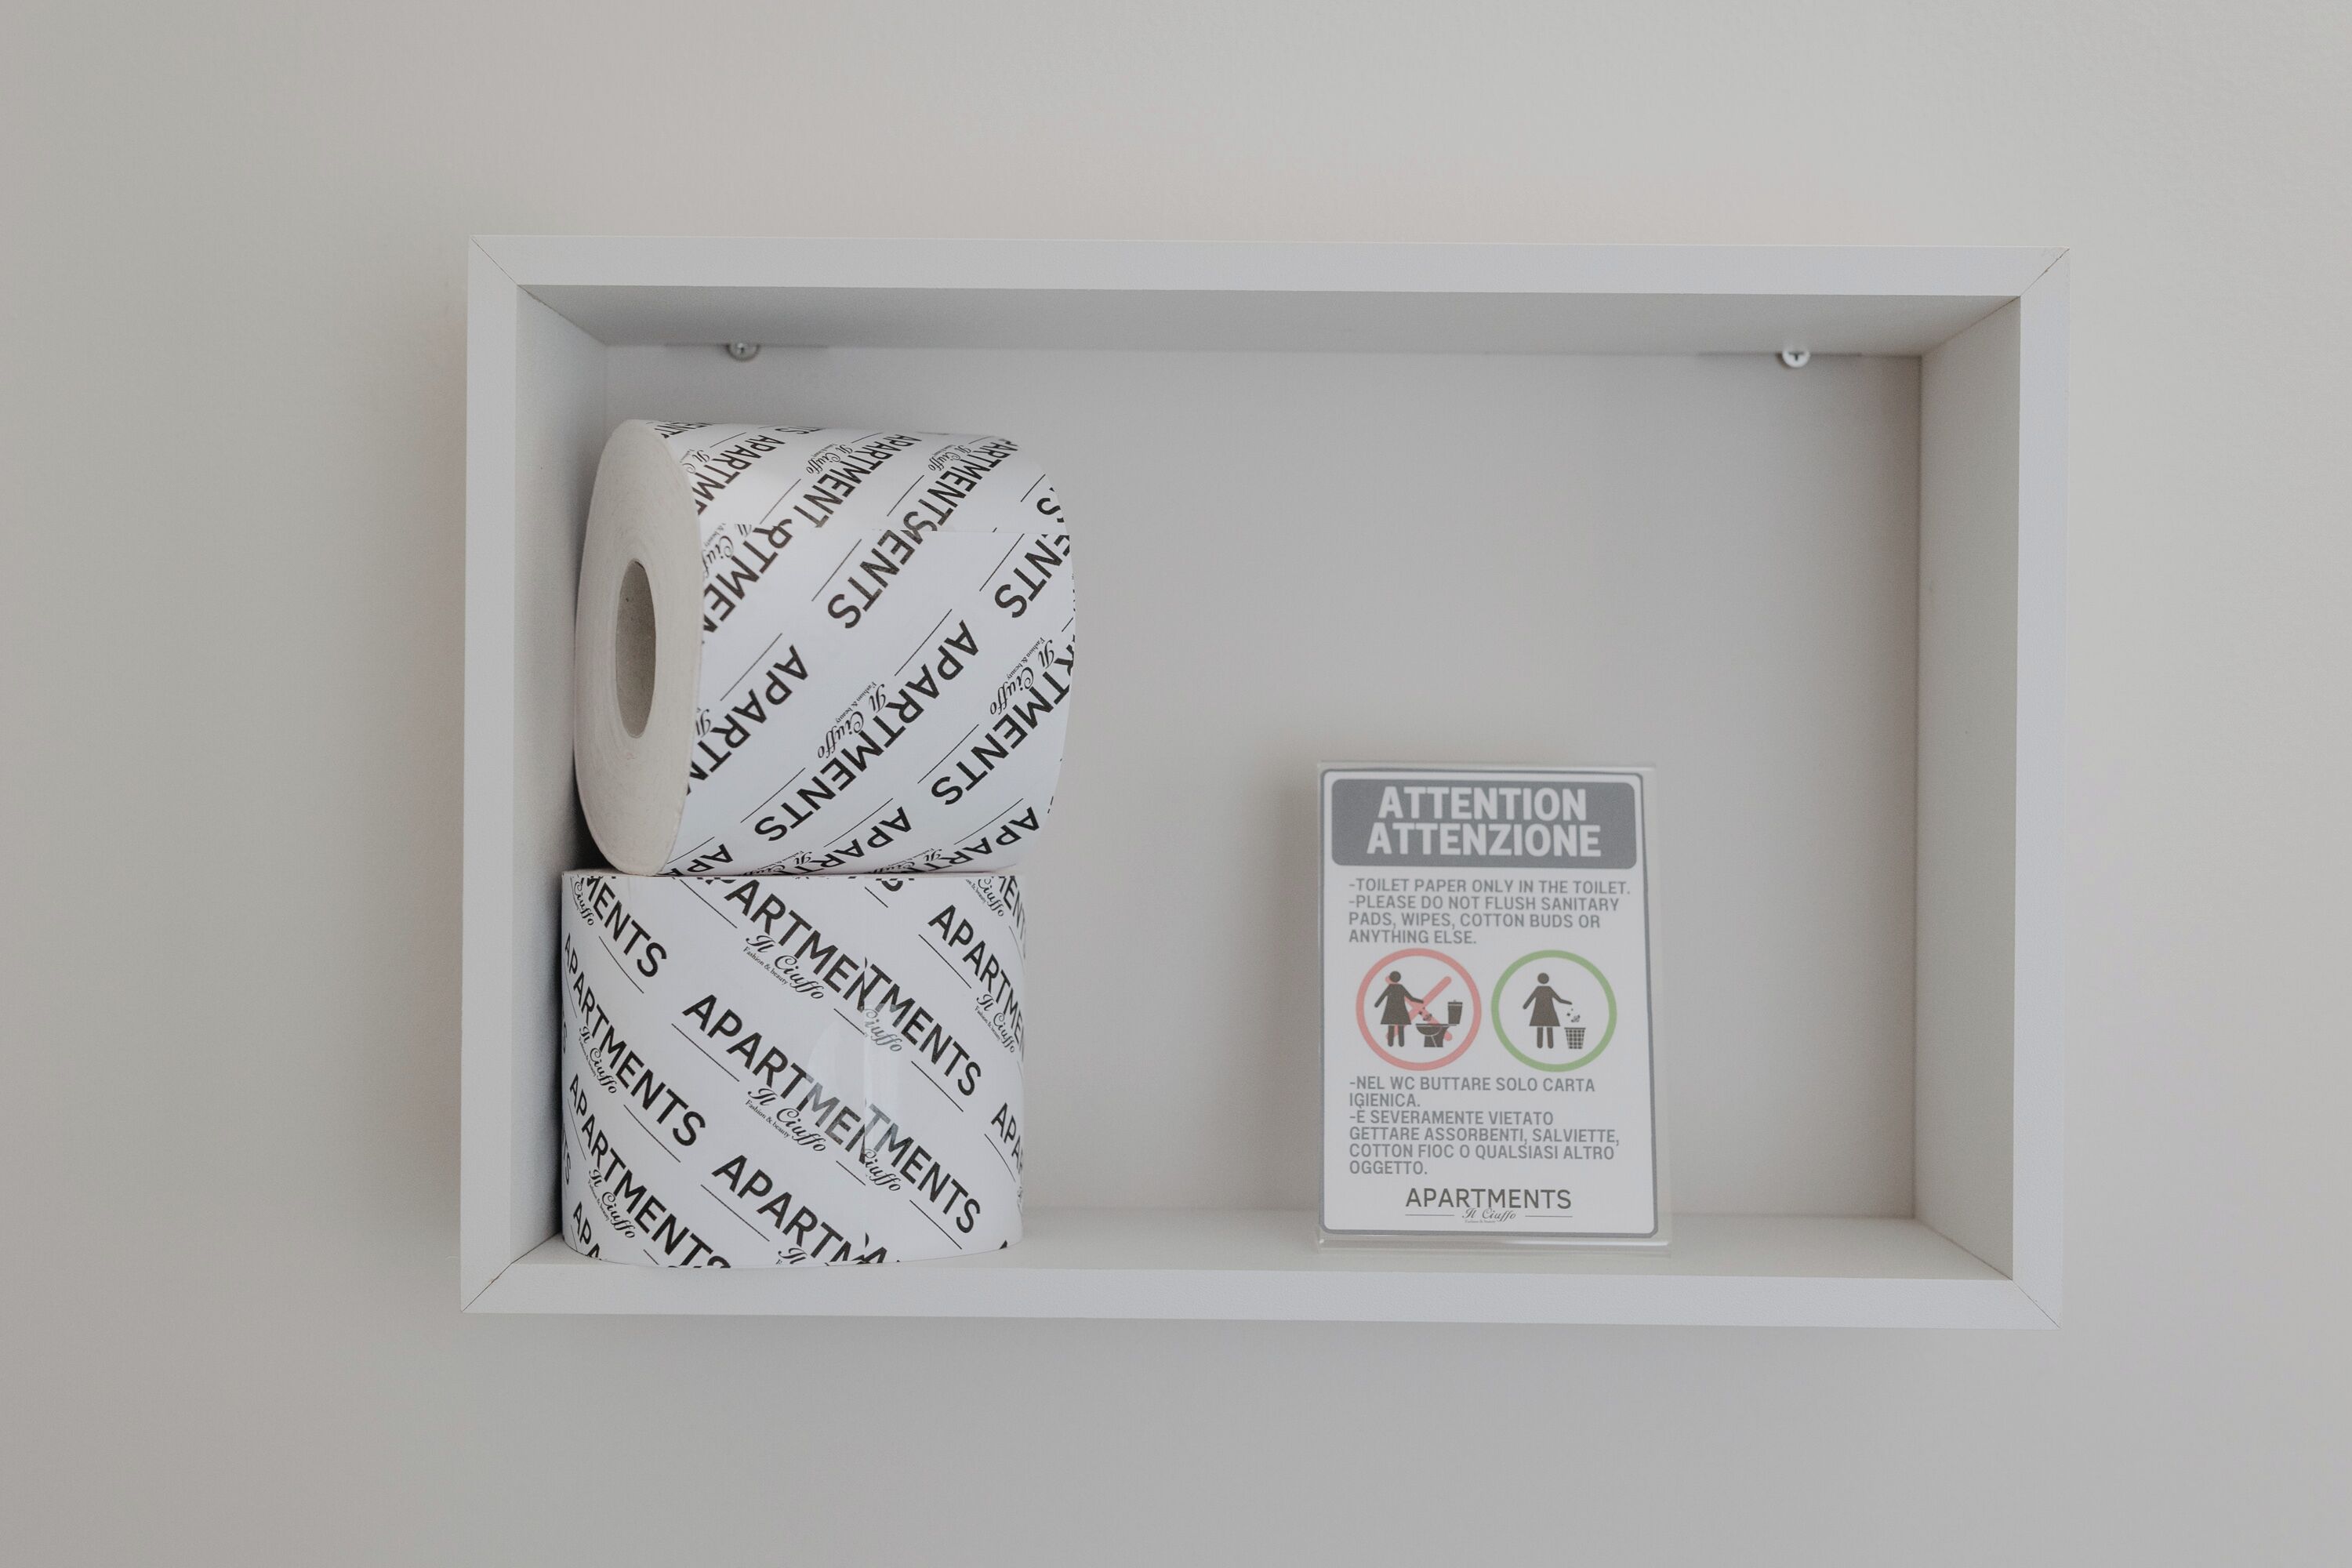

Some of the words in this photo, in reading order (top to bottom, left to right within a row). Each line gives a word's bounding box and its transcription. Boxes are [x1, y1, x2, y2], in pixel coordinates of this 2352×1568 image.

[806, 452, 841, 474] Ciuffo
[775, 434, 923, 528] APARTMENT
[1037, 639, 1055, 669] Il
[869, 684, 887, 713] Il
[990, 666, 1034, 715] Ciuffo
[754, 619, 979, 841] APARTMENTS
[818, 711, 864, 759] Ciuffo
[1378, 786, 1587, 821] ATTENTION
[1367, 822, 1602, 857] ATTENZIONE
[1348, 878, 1410, 891] -TOILET
[1414, 879, 1467, 892] PAPER
[1472, 879, 1514, 893] ONLY
[1519, 880, 1534, 893] IN
[1538, 880, 1568, 894] THE
[1573, 880, 1631, 895] TOILET.
[574, 880, 595, 926] Ciuffo
[1348, 895, 1416, 909] -PLEASE
[1421, 895, 1443, 909] DO
[1449, 896, 1480, 909] NOT
[1485, 896, 1536, 910] FLUSH
[1541, 897, 1619, 911] SANITARY
[1348, 912, 1396, 929] PADS,
[1401, 913, 1455, 930] WIPES,
[1460, 913, 1525, 927] COTTON
[1530, 914, 1573, 928] BUDS
[1578, 914, 1600, 928] OR
[1348, 929, 1429, 944] ANYTHING
[1434, 930, 1477, 944] ELSE.
[742, 946, 765, 967] Fashion
[764, 963, 771, 971] &
[770, 967, 789, 985] beauty
[745, 935, 776, 953] Il
[774, 955, 824, 1000] Ciuffo
[564, 932, 706, 1146] APARTMENTS
[976, 993, 994, 1011] Il
[993, 1012, 1015, 1054] Ciuffo
[590, 1047, 618, 1094] Ciuffo
[1349, 1076, 1385, 1090] -NEL
[1390, 1076, 1415, 1090] WC
[1420, 1076, 1491, 1091] BUTTARE
[1496, 1077, 1537, 1091] SOLO
[1543, 1078, 1595, 1092] CARTA
[1349, 1093, 1421, 1107] IGIENICA.
[745, 1098, 768, 1120] Fashion
[772, 1121, 790, 1138] beauty
[747, 1087, 778, 1106] Il
[776, 1107, 826, 1152] Ciuffo
[1370, 1109, 1484, 1124] SEVERAMENTE
[1489, 1111, 1554, 1125] VIETATO
[1349, 1126, 1420, 1141] GETTARE
[1424, 1127, 1528, 1145] ASSORBENTI,
[1532, 1128, 1620, 1146] SALVIETTE,
[1349, 1143, 1413, 1158] COTTON
[1418, 1144, 1454, 1158] FIOC
[1459, 1144, 1470, 1159] O
[1475, 1145, 1559, 1160] QUALSIASI
[1563, 1145, 1614, 1160] ALTRO
[1349, 1160, 1428, 1175] OGGETTO.
[1405, 1188, 1572, 1209] APARTMENTS
[1461, 1207, 1477, 1218] Il
[1482, 1207, 1517, 1222] Ciuffo
[601, 1191, 636, 1239] Ciuffo
